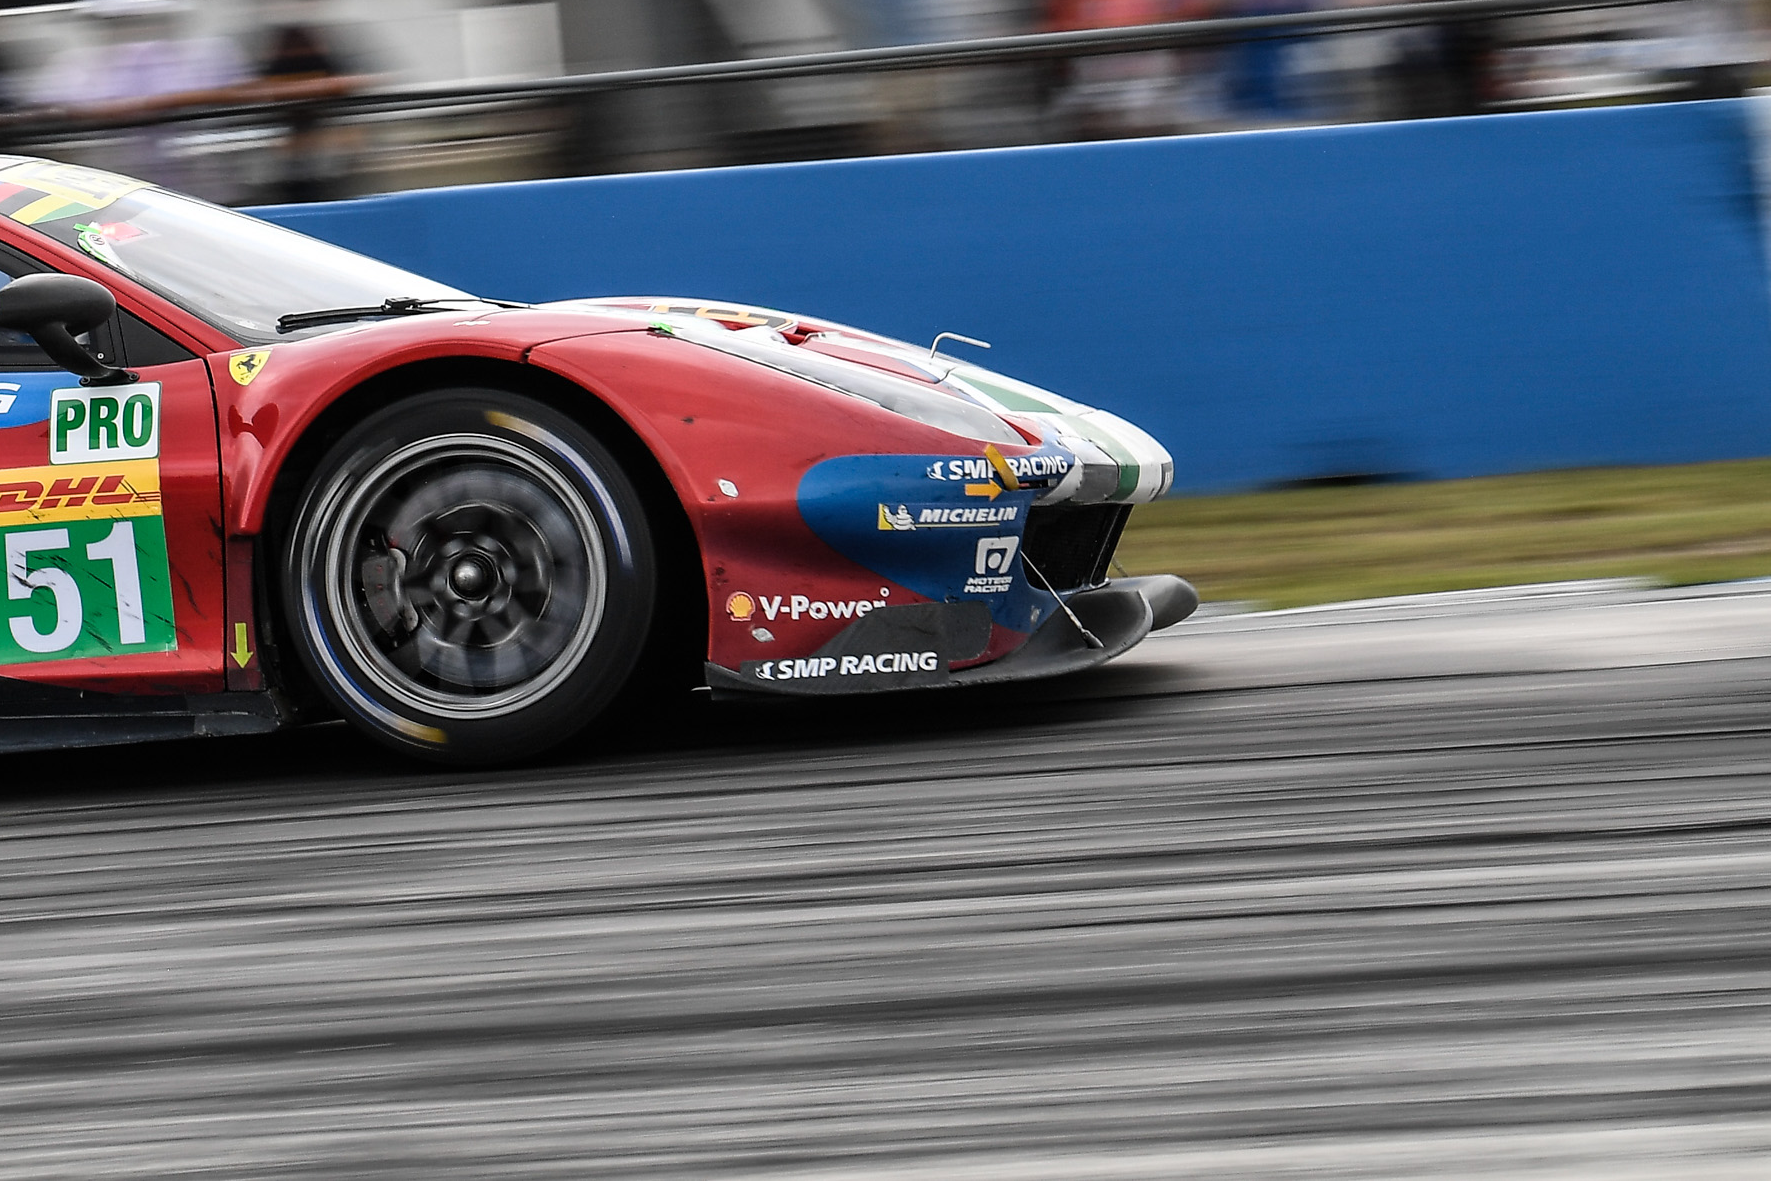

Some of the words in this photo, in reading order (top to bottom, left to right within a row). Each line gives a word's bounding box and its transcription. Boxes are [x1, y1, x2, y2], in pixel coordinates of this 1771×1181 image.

[55, 392, 155, 454] PRO
[1008, 455, 1068, 477] RACING
[919, 506, 1018, 524] MICHELIN
[3, 519, 148, 654] 51
[966, 576, 1013, 585] MOTEGI
[776, 657, 837, 681] SMP
[839, 651, 939, 676] RACING
